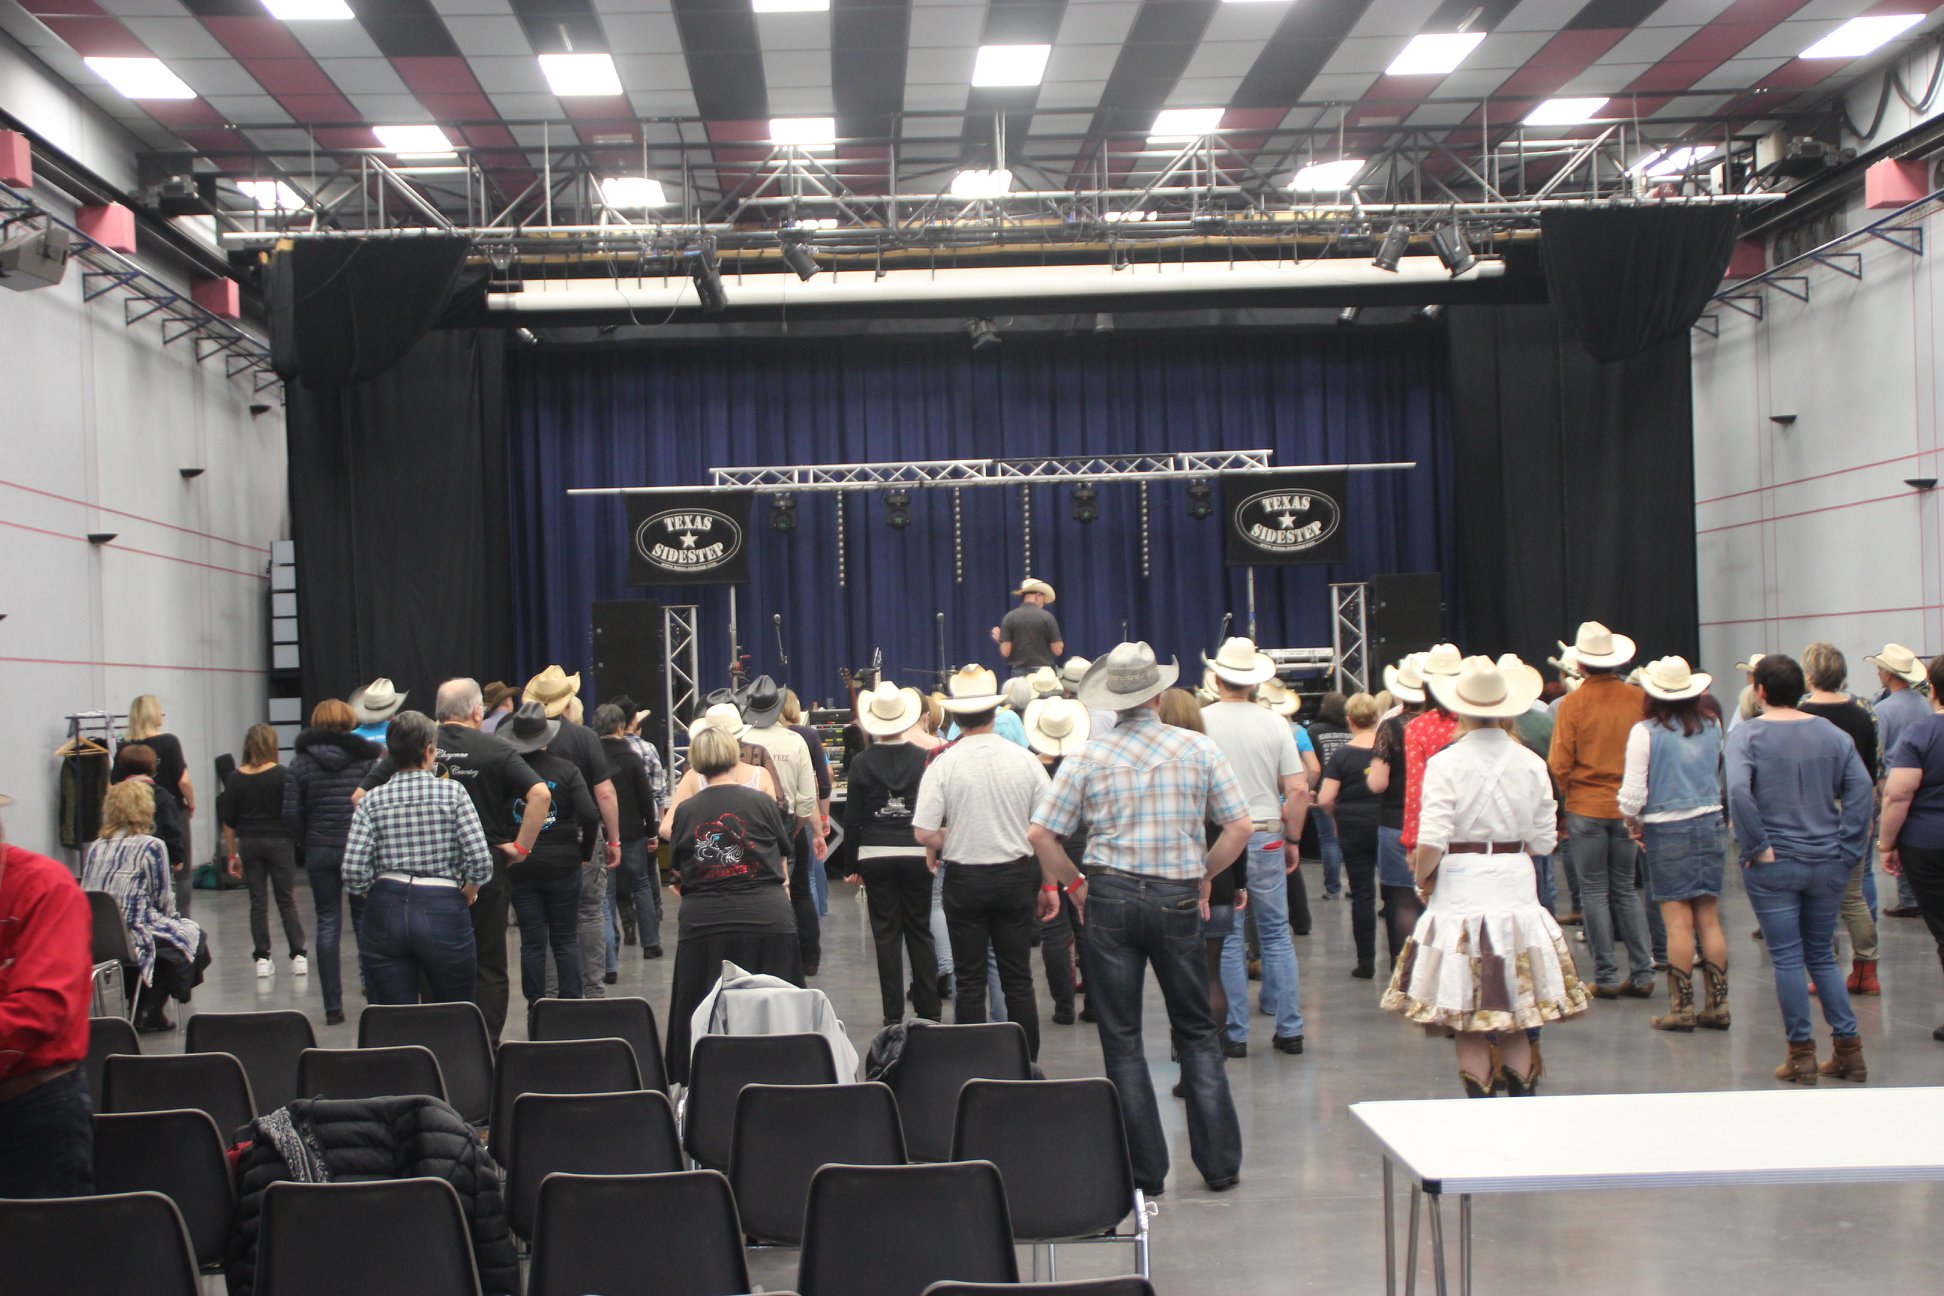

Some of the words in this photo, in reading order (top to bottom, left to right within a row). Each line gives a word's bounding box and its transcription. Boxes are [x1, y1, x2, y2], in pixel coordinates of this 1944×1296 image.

[1262, 496, 1311, 512] TEXAS
[664, 515, 713, 531] TEXAS
[1251, 521, 1322, 543] SIDESTEP
[652, 542, 724, 563] SIDESTEP
